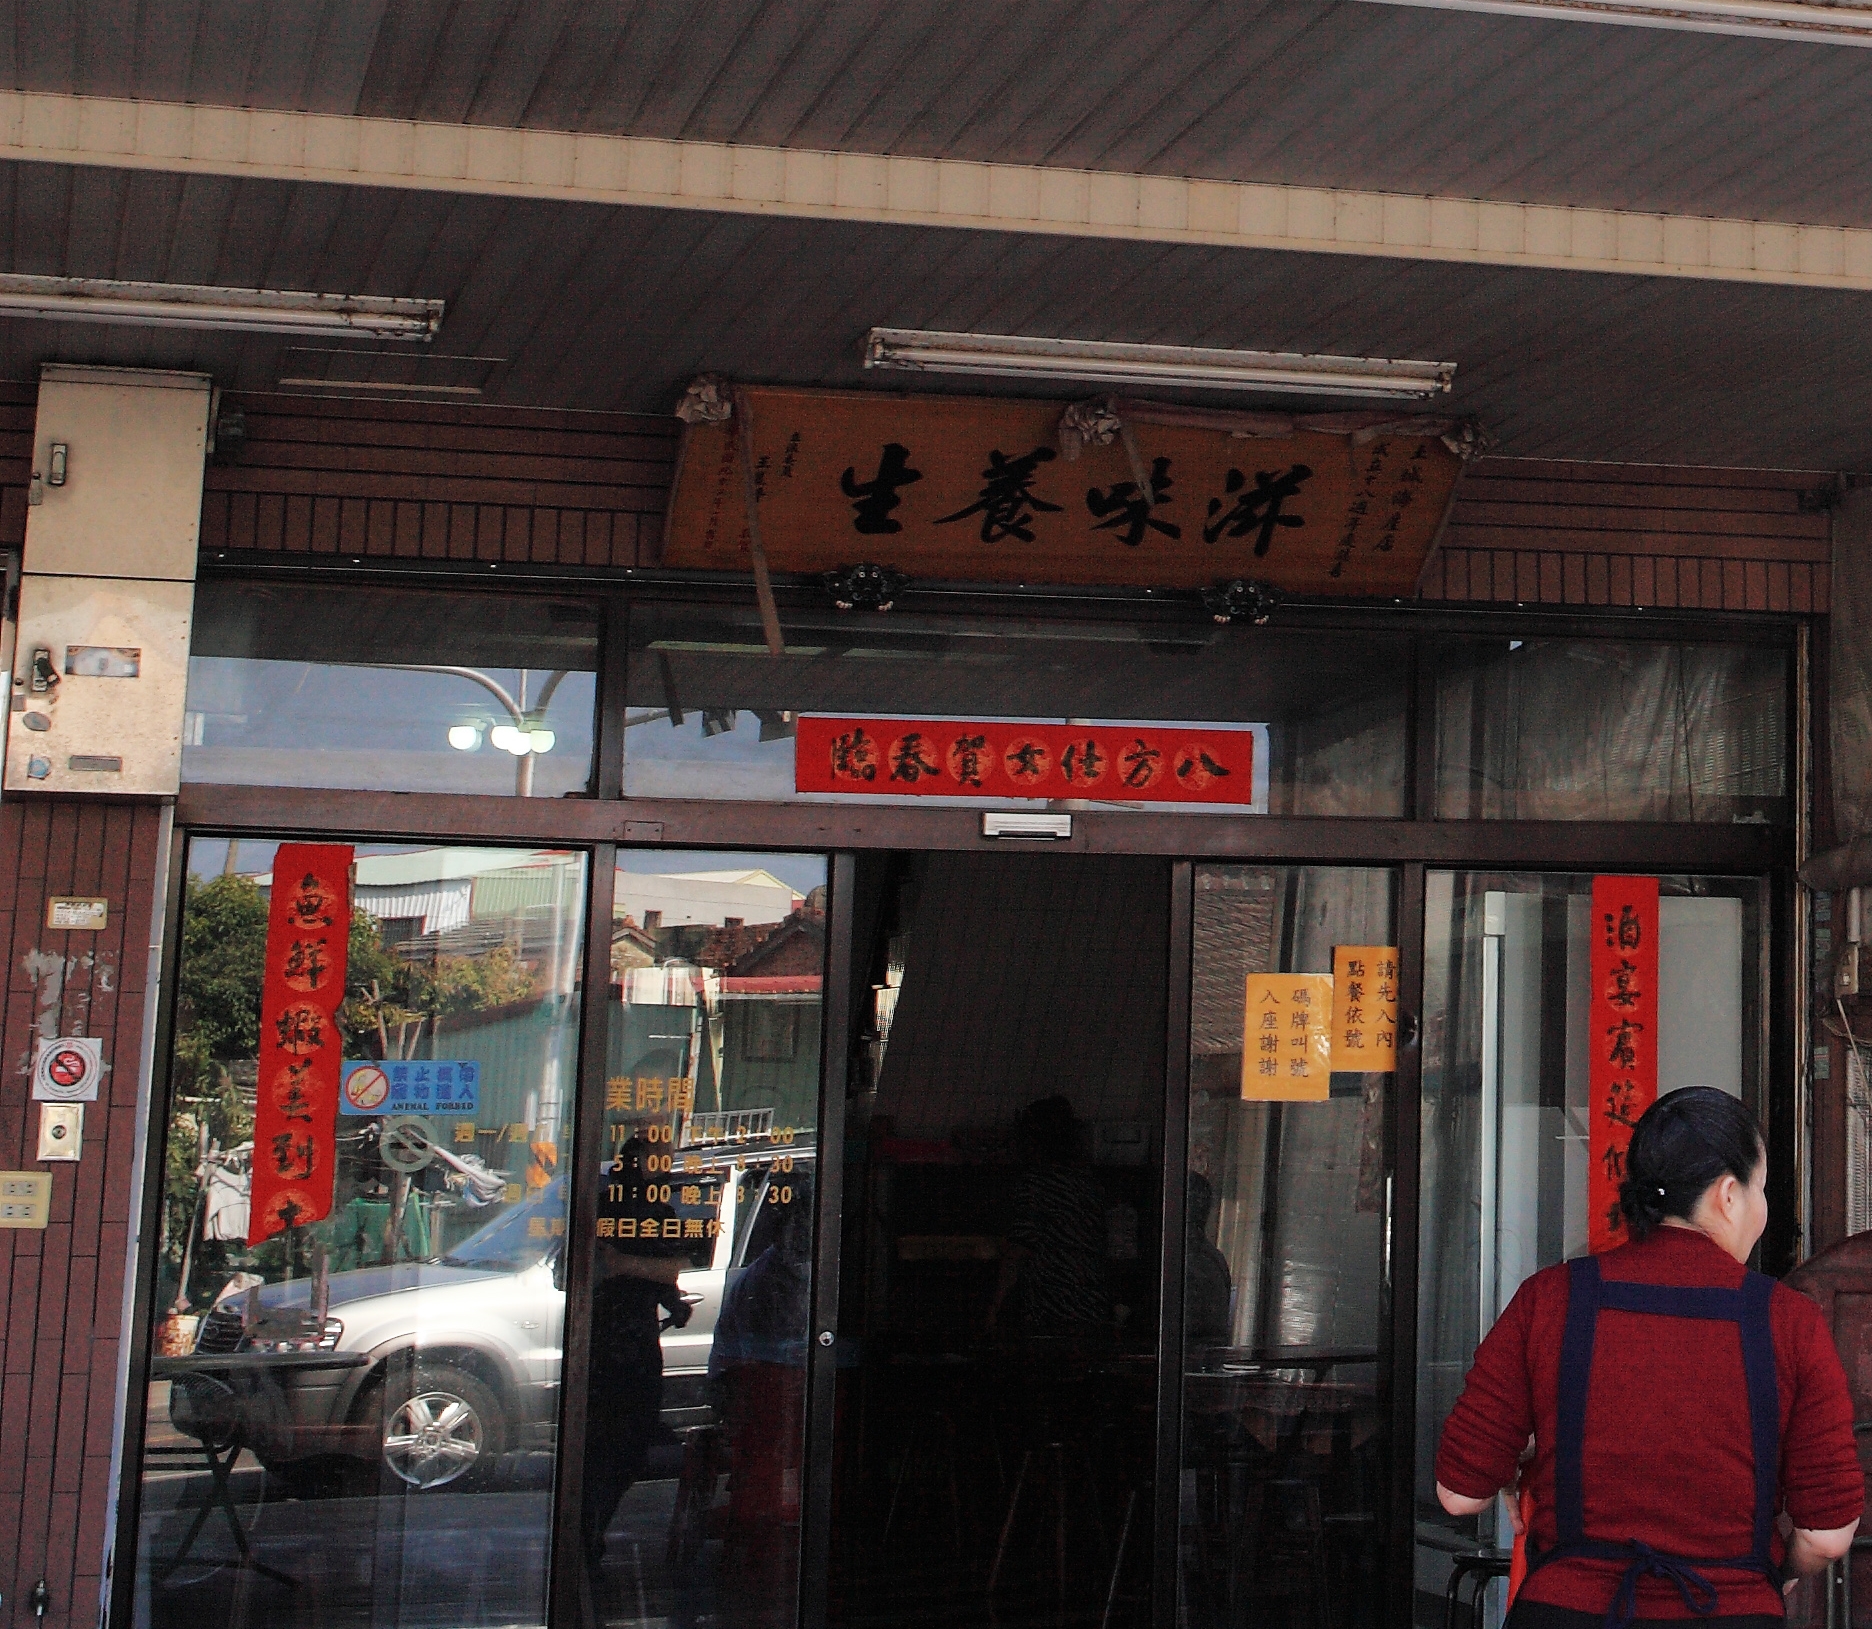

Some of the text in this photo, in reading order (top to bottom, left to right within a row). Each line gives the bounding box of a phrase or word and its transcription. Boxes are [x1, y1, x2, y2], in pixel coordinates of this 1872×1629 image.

[1258, 989, 1280, 1077] 入座謝謝
[1344, 959, 1365, 1049] 點餐依號
[1375, 959, 1396, 1048] 請先入內
